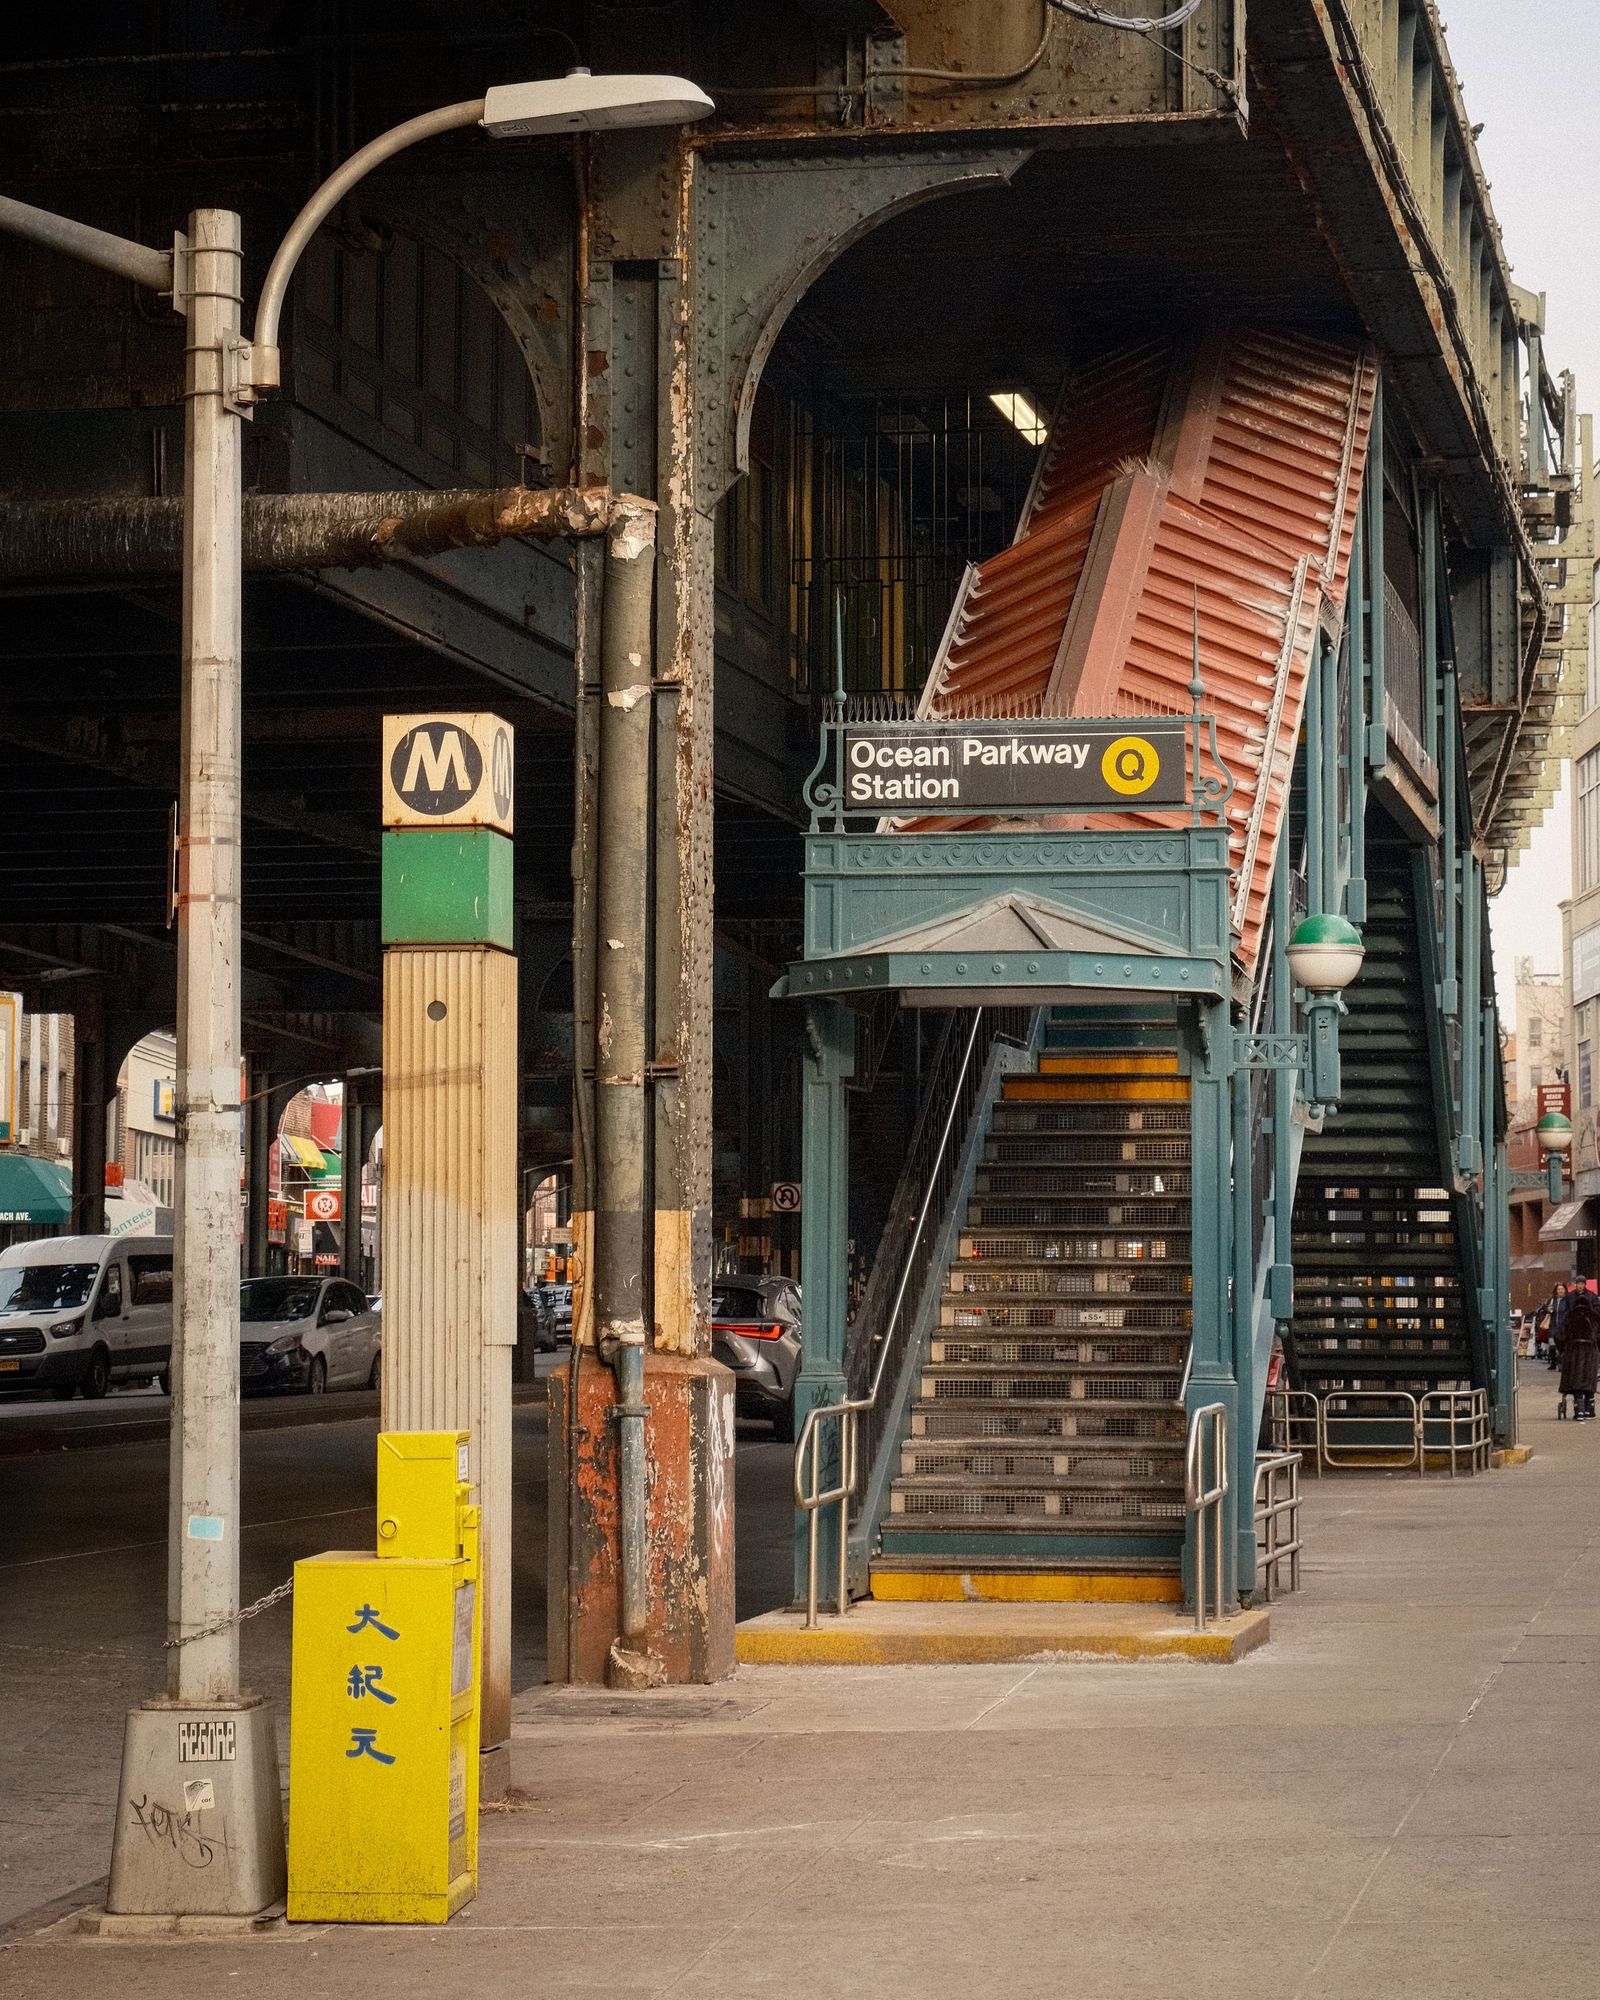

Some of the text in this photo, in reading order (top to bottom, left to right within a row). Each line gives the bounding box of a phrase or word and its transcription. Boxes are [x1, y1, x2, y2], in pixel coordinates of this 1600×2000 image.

[401, 730, 472, 791] M
[850, 738, 1091, 769] Ocean Parkway
[1115, 748, 1145, 781] Q
[850, 773, 960, 801] Station
[15, 1211, 32, 1221] AVE.
